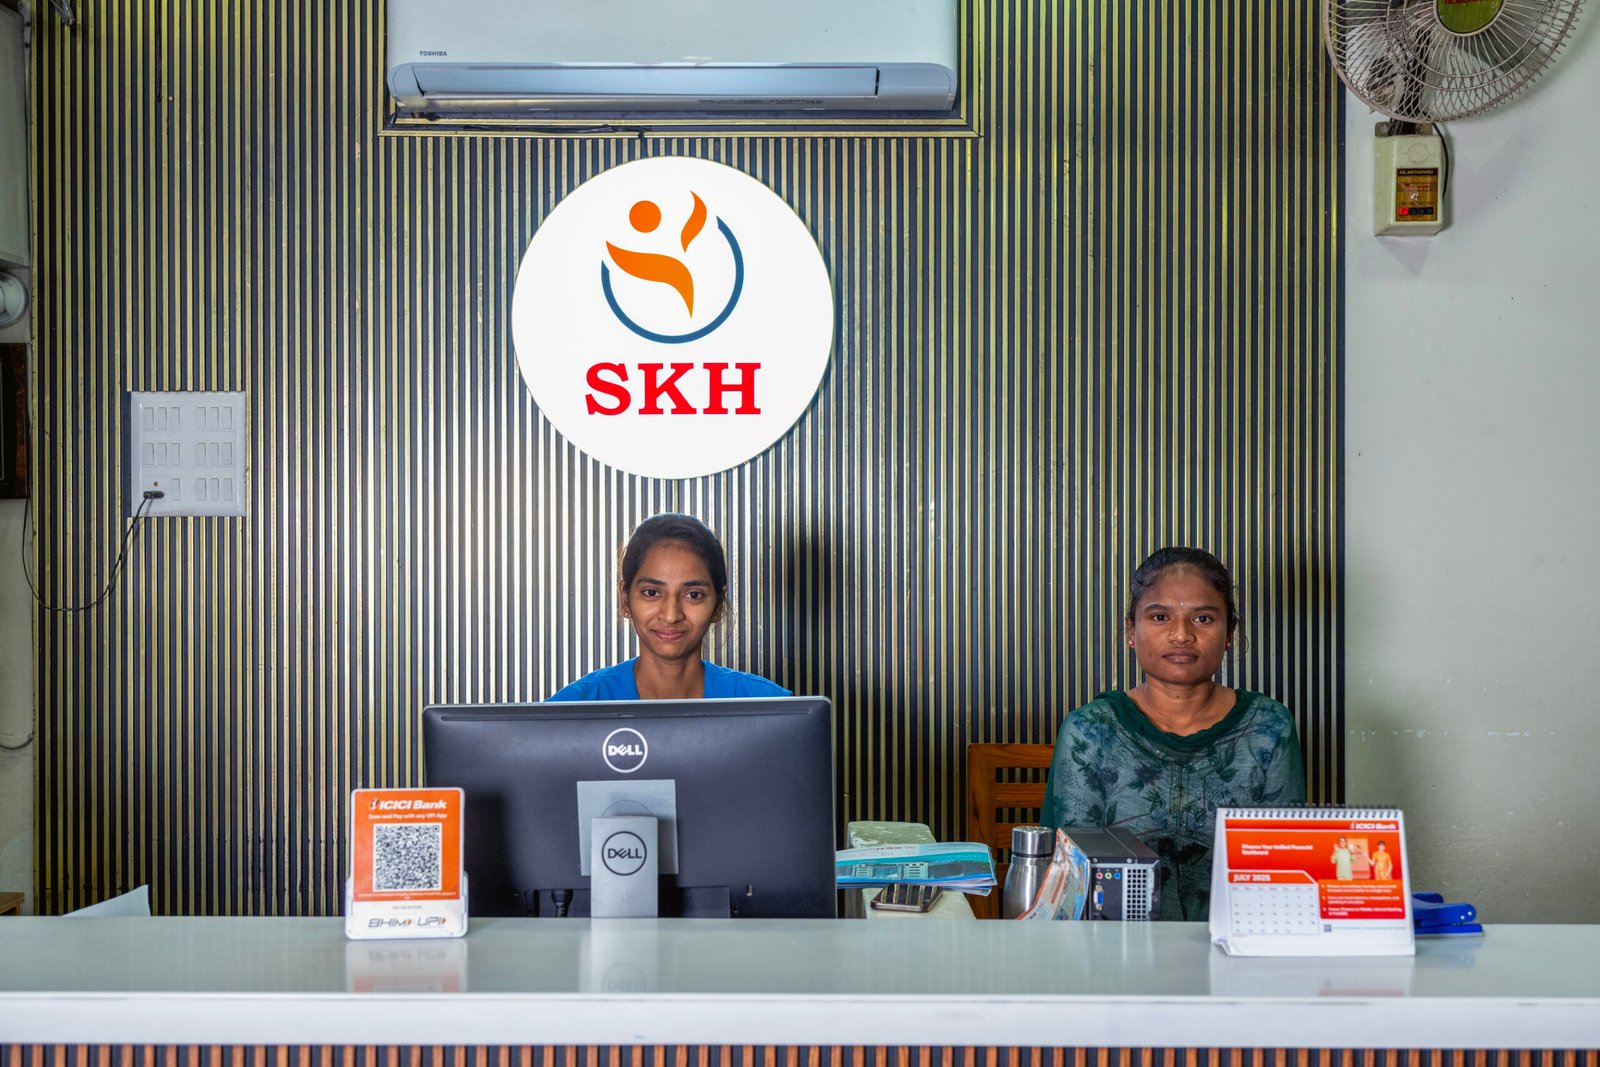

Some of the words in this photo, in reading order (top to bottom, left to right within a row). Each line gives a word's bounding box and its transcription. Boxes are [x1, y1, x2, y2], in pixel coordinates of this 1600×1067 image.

[585, 362, 761, 416] SKH
[608, 744, 642, 756] DELL
[379, 800, 412, 810] ICICI
[413, 799, 447, 809] Bank
[608, 847, 642, 859] DELL
[1233, 873, 1251, 882] JULY
[1252, 874, 1271, 882] 2025
